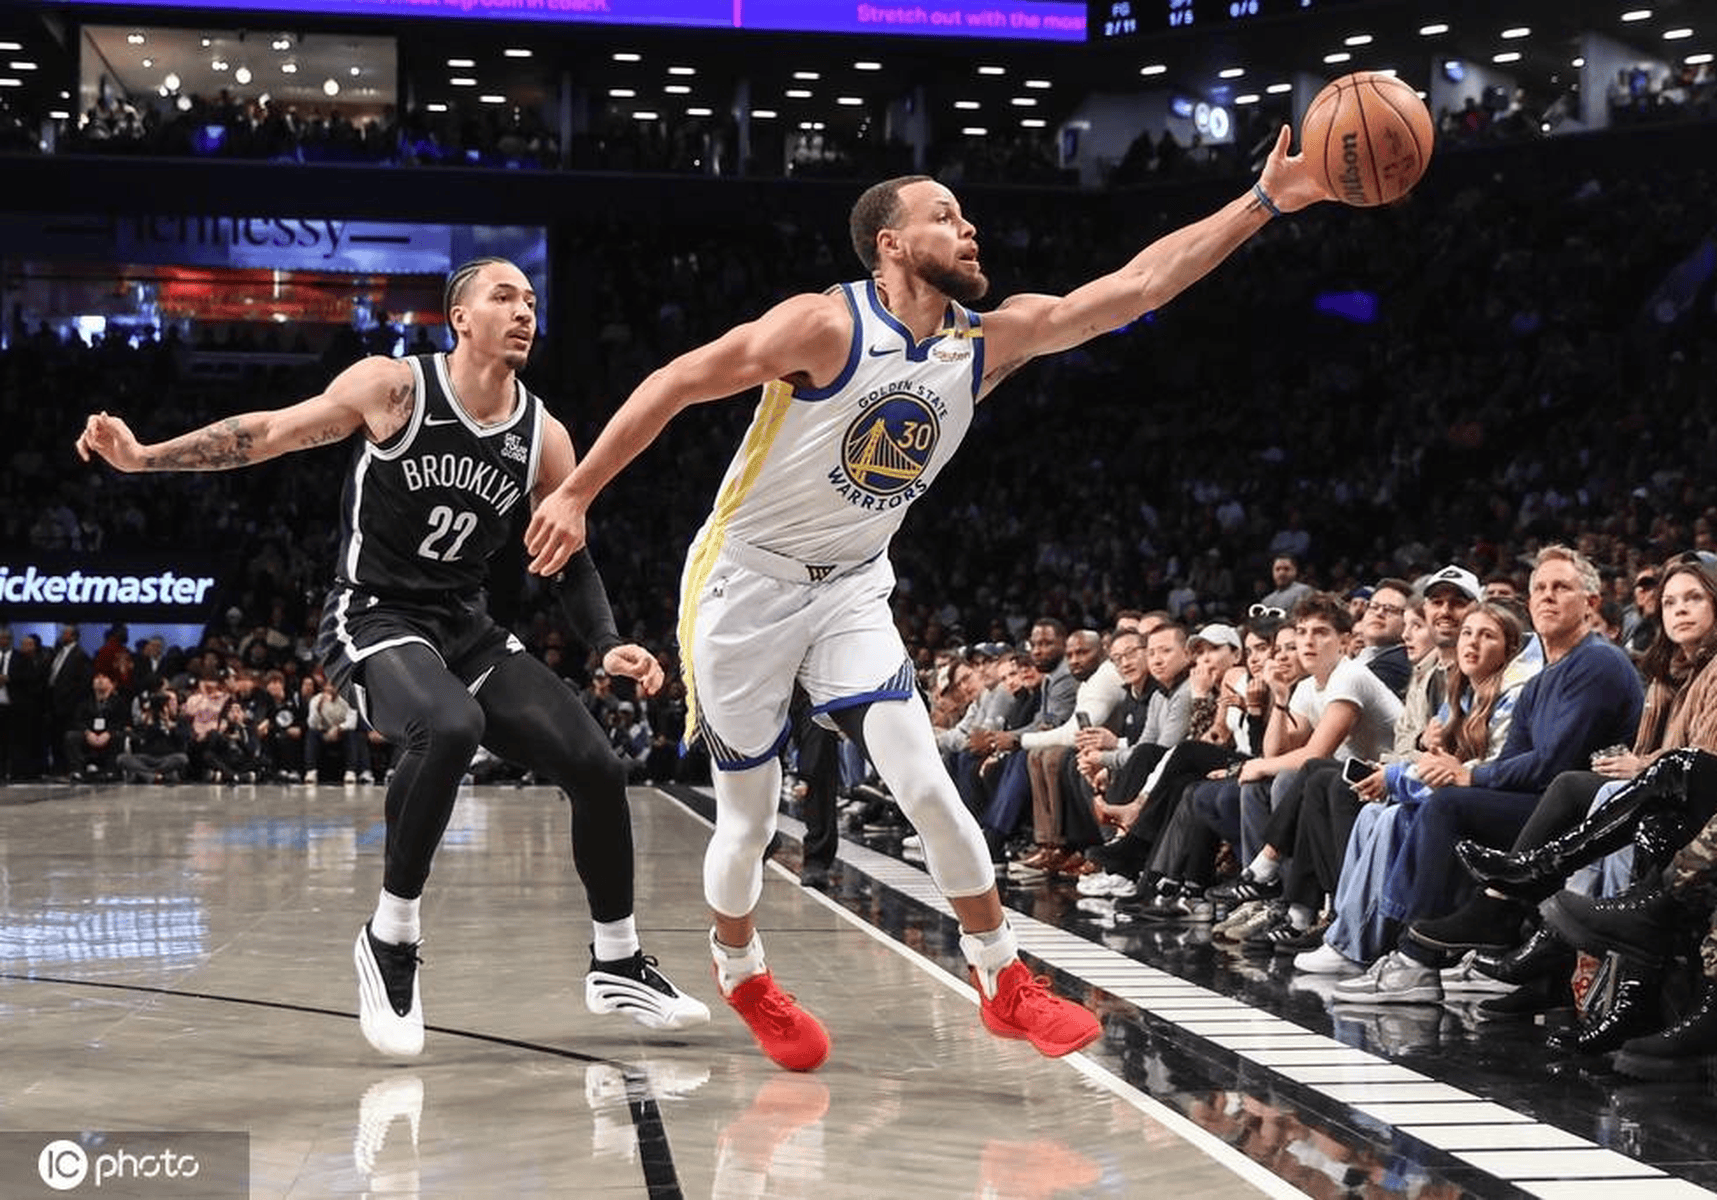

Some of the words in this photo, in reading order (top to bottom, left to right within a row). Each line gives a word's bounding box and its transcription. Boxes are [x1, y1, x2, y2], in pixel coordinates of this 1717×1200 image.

[858, 4, 928, 23] Stretch
[930, 10, 962, 26] out
[964, 9, 1007, 28] with
[1009, 10, 1041, 28] the
[858, 380, 913, 409] GOLDEN
[917, 385, 948, 420] STATE
[898, 421, 932, 450] 30
[402, 454, 521, 517] BROOKLYN
[827, 465, 927, 511] WARRIORS
[418, 505, 478, 562] 22
